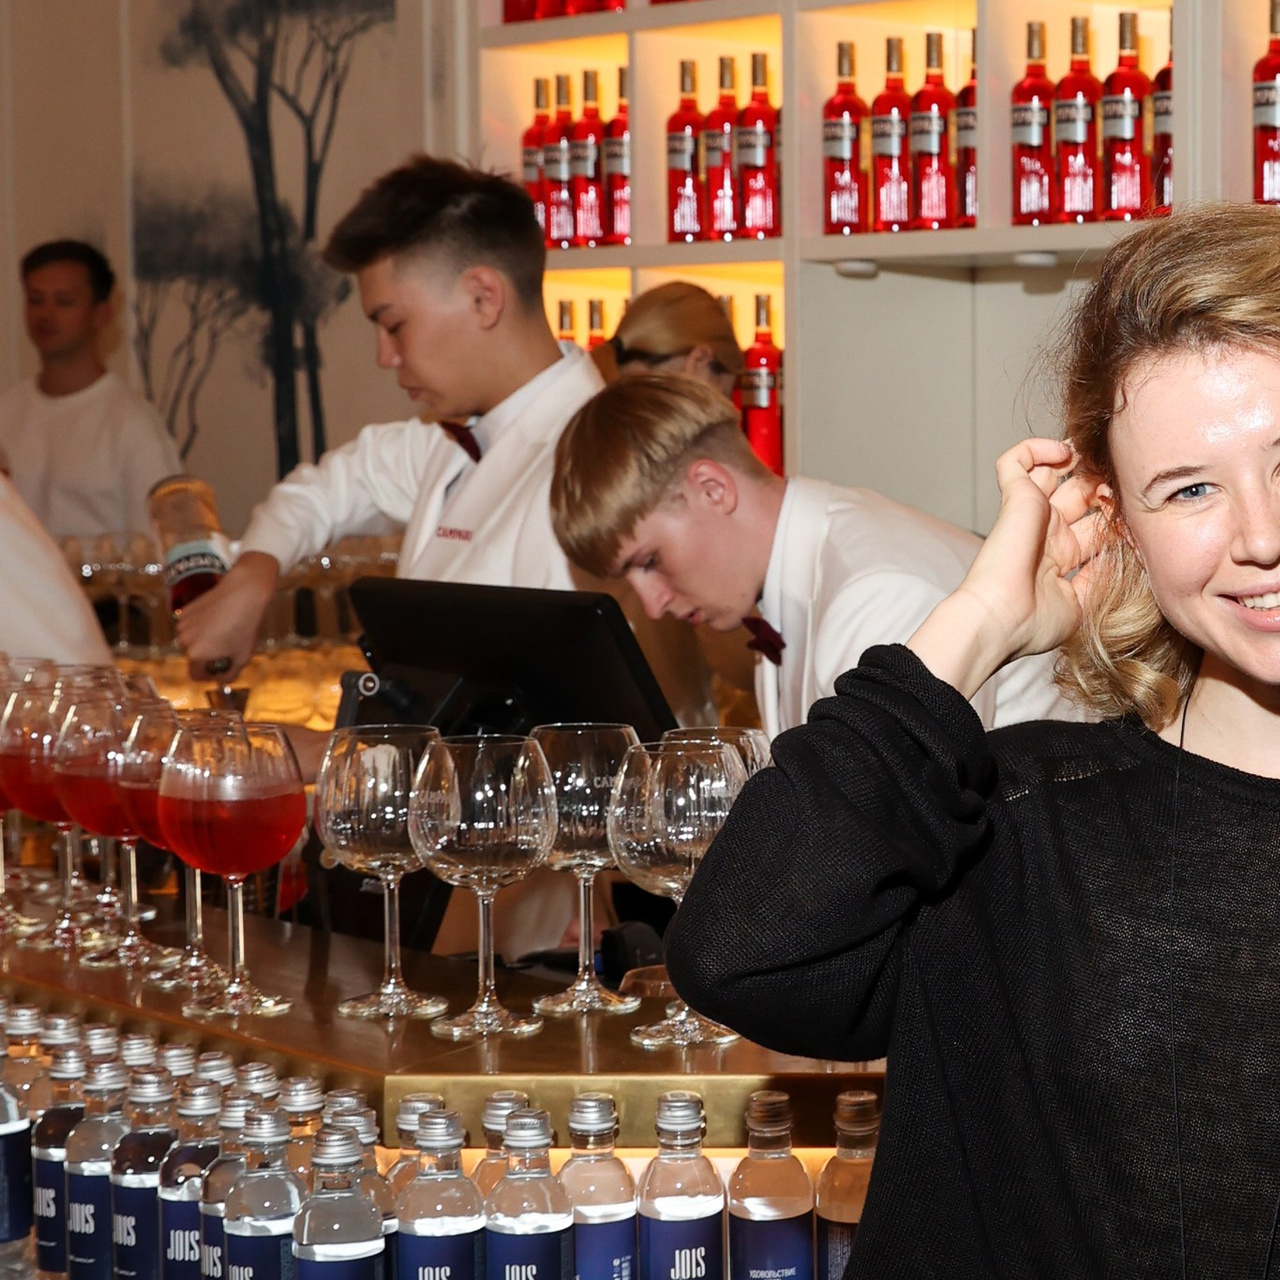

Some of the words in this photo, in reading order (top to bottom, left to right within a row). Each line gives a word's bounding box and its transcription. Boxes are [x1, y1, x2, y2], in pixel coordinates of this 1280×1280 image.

[167, 1229, 200, 1262] JOIS
[670, 1246, 706, 1280] JOIS
[749, 1267, 797, 1279] УДОВОЛЬСТВИЕ
